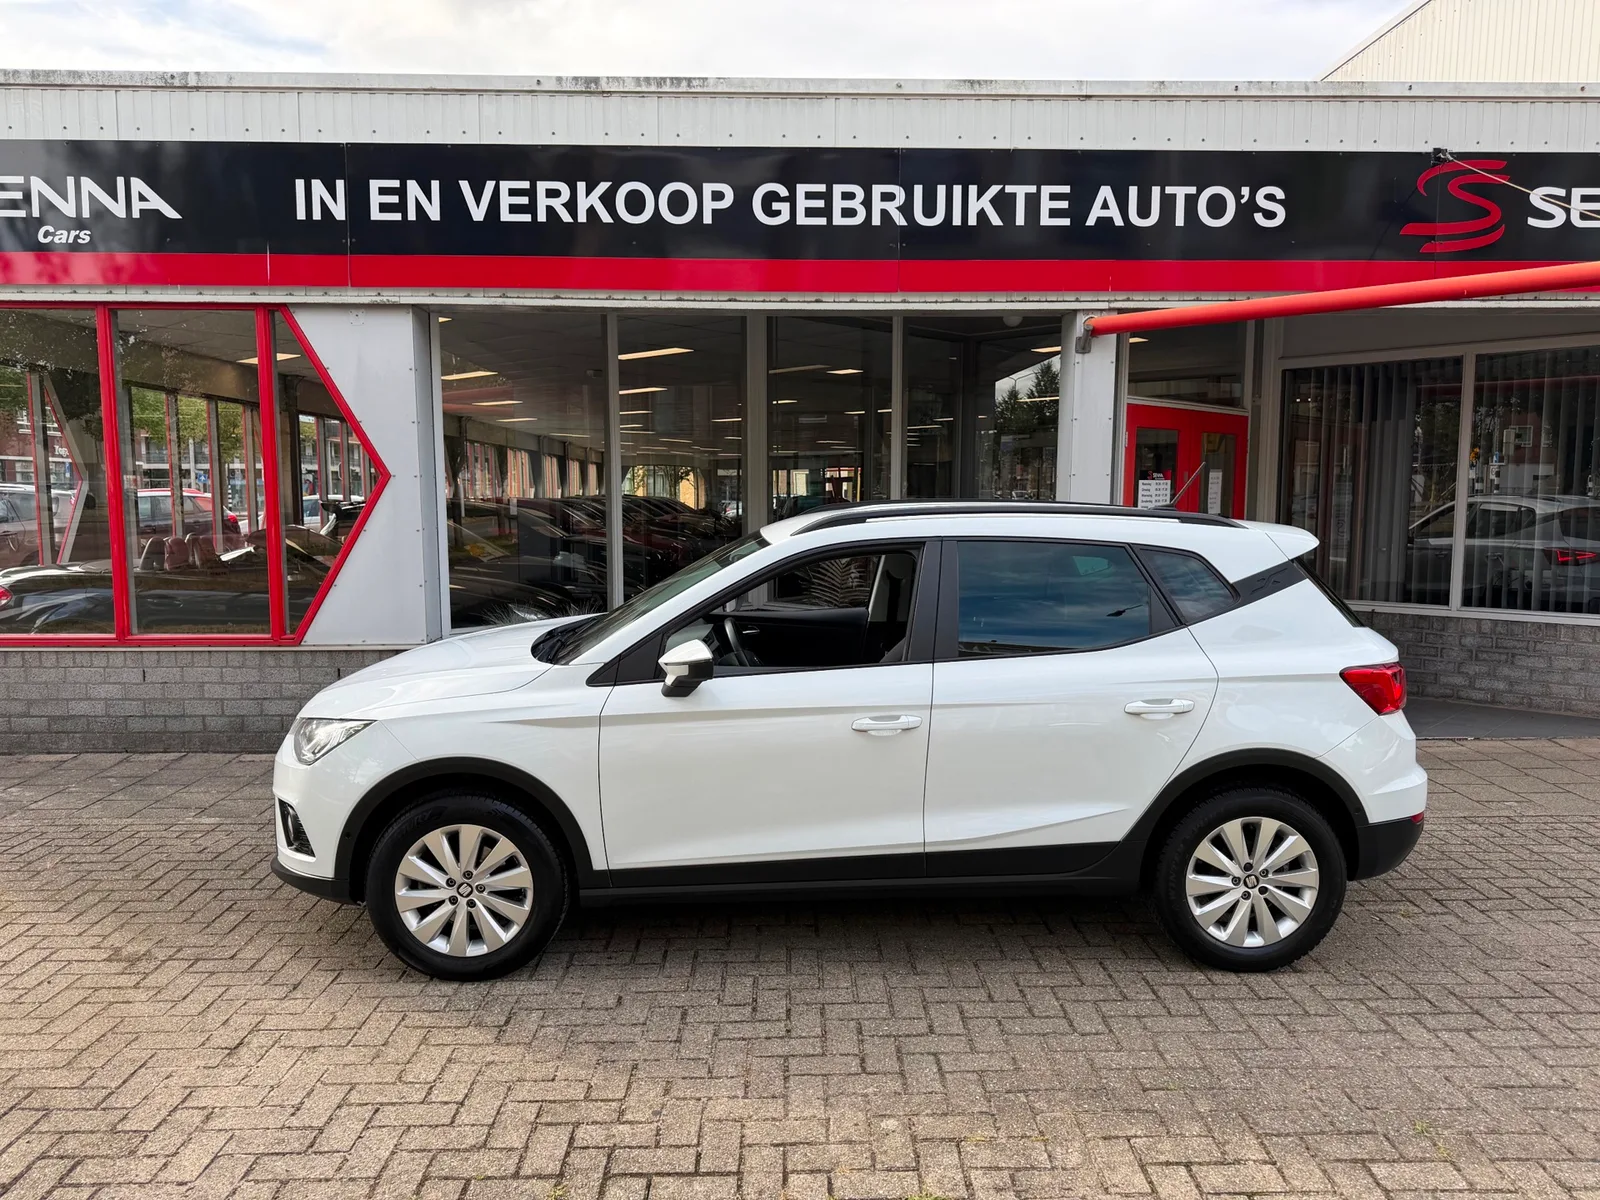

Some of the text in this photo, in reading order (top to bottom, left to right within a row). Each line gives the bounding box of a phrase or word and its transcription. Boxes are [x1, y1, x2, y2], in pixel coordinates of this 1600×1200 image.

[296, 179, 346, 221] IN
[370, 180, 441, 221] EN
[459, 181, 734, 225] VERKOOP
[752, 183, 1071, 226] GEBRUIKTE
[37, 225, 92, 244] Cars
